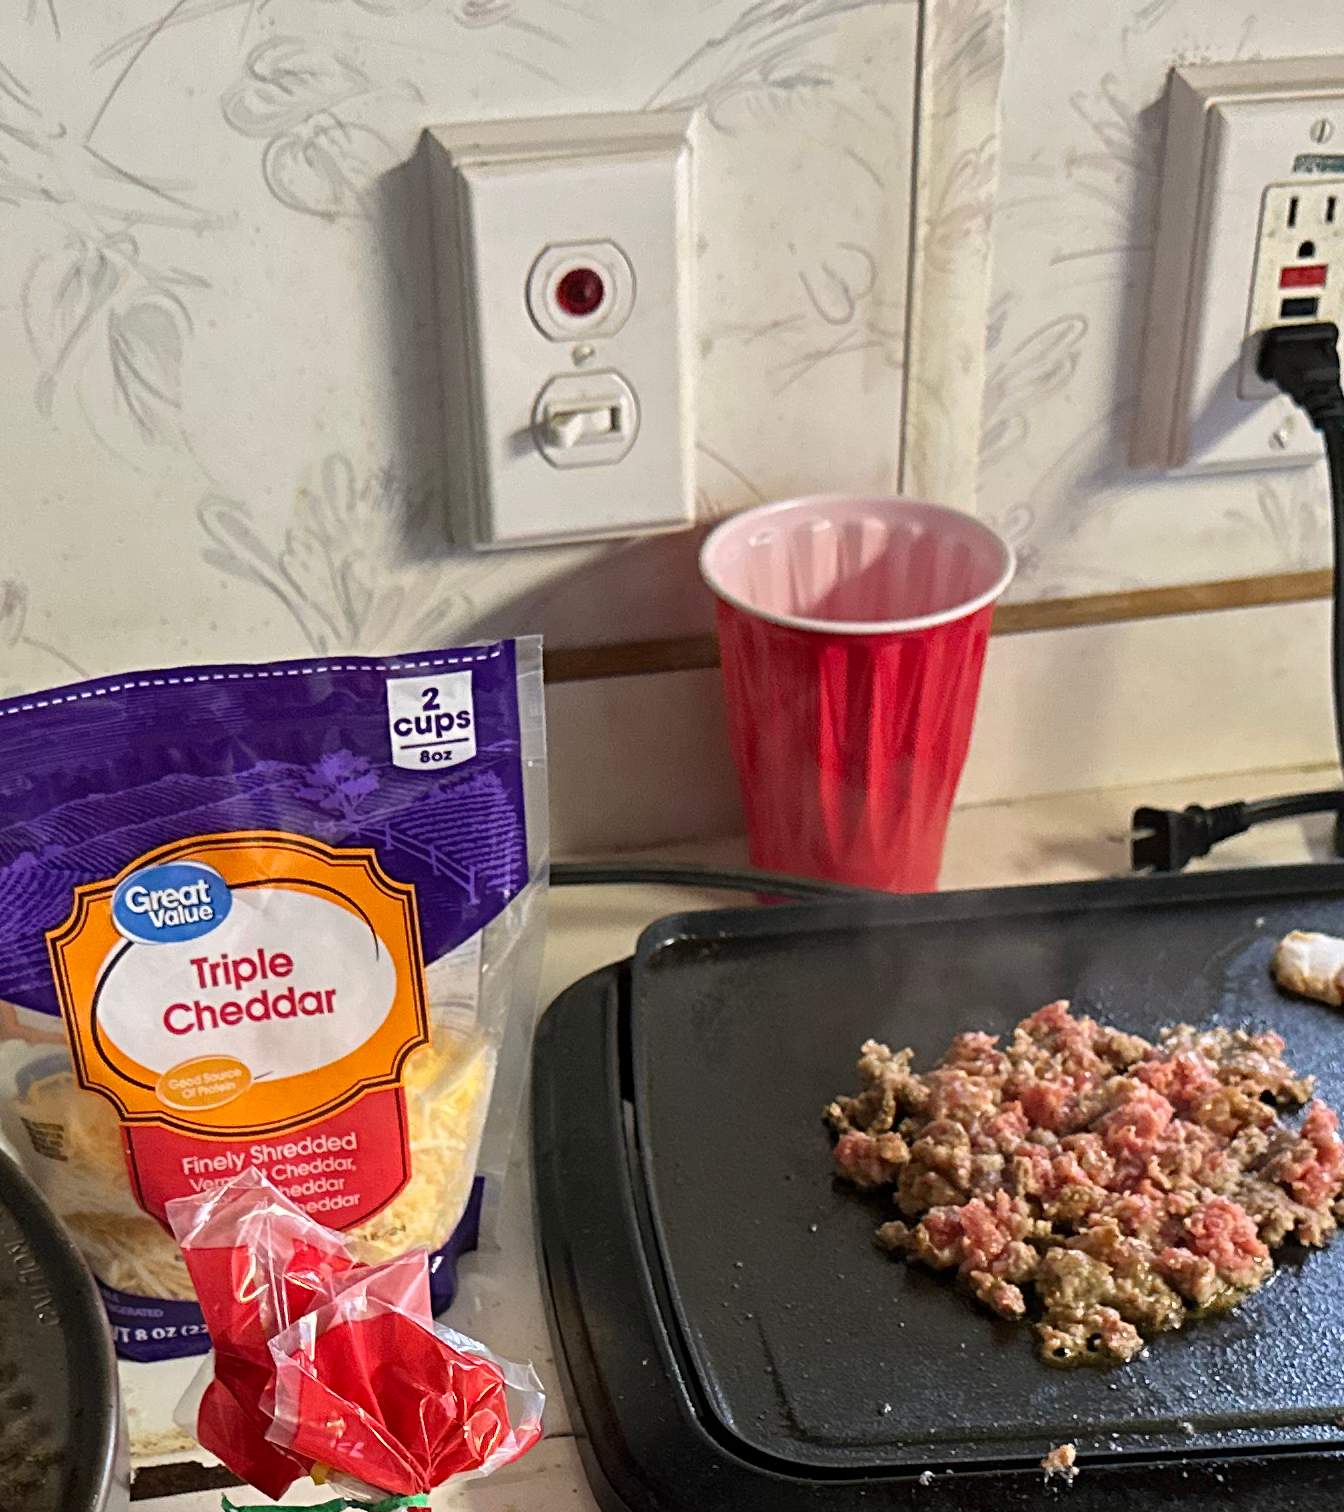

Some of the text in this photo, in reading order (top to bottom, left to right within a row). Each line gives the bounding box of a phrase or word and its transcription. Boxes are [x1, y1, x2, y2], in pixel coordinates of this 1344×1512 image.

[421, 687, 441, 712] 2
[393, 710, 471, 738] cups
[419, 749, 452, 763] 8oz
[125, 879, 212, 914] Great
[148, 904, 214, 928] Value
[189, 948, 294, 991] Triple
[162, 986, 337, 1036] Cheddar
[168, 1068, 243, 1091] Good Source
[198, 1081, 237, 1097] Protein
[182, 1132, 358, 1176] Finely Shredded
[277, 1177, 345, 1198] heddar
[134, 1328, 148, 1342] 8
[152, 1326, 178, 1340] OZ
